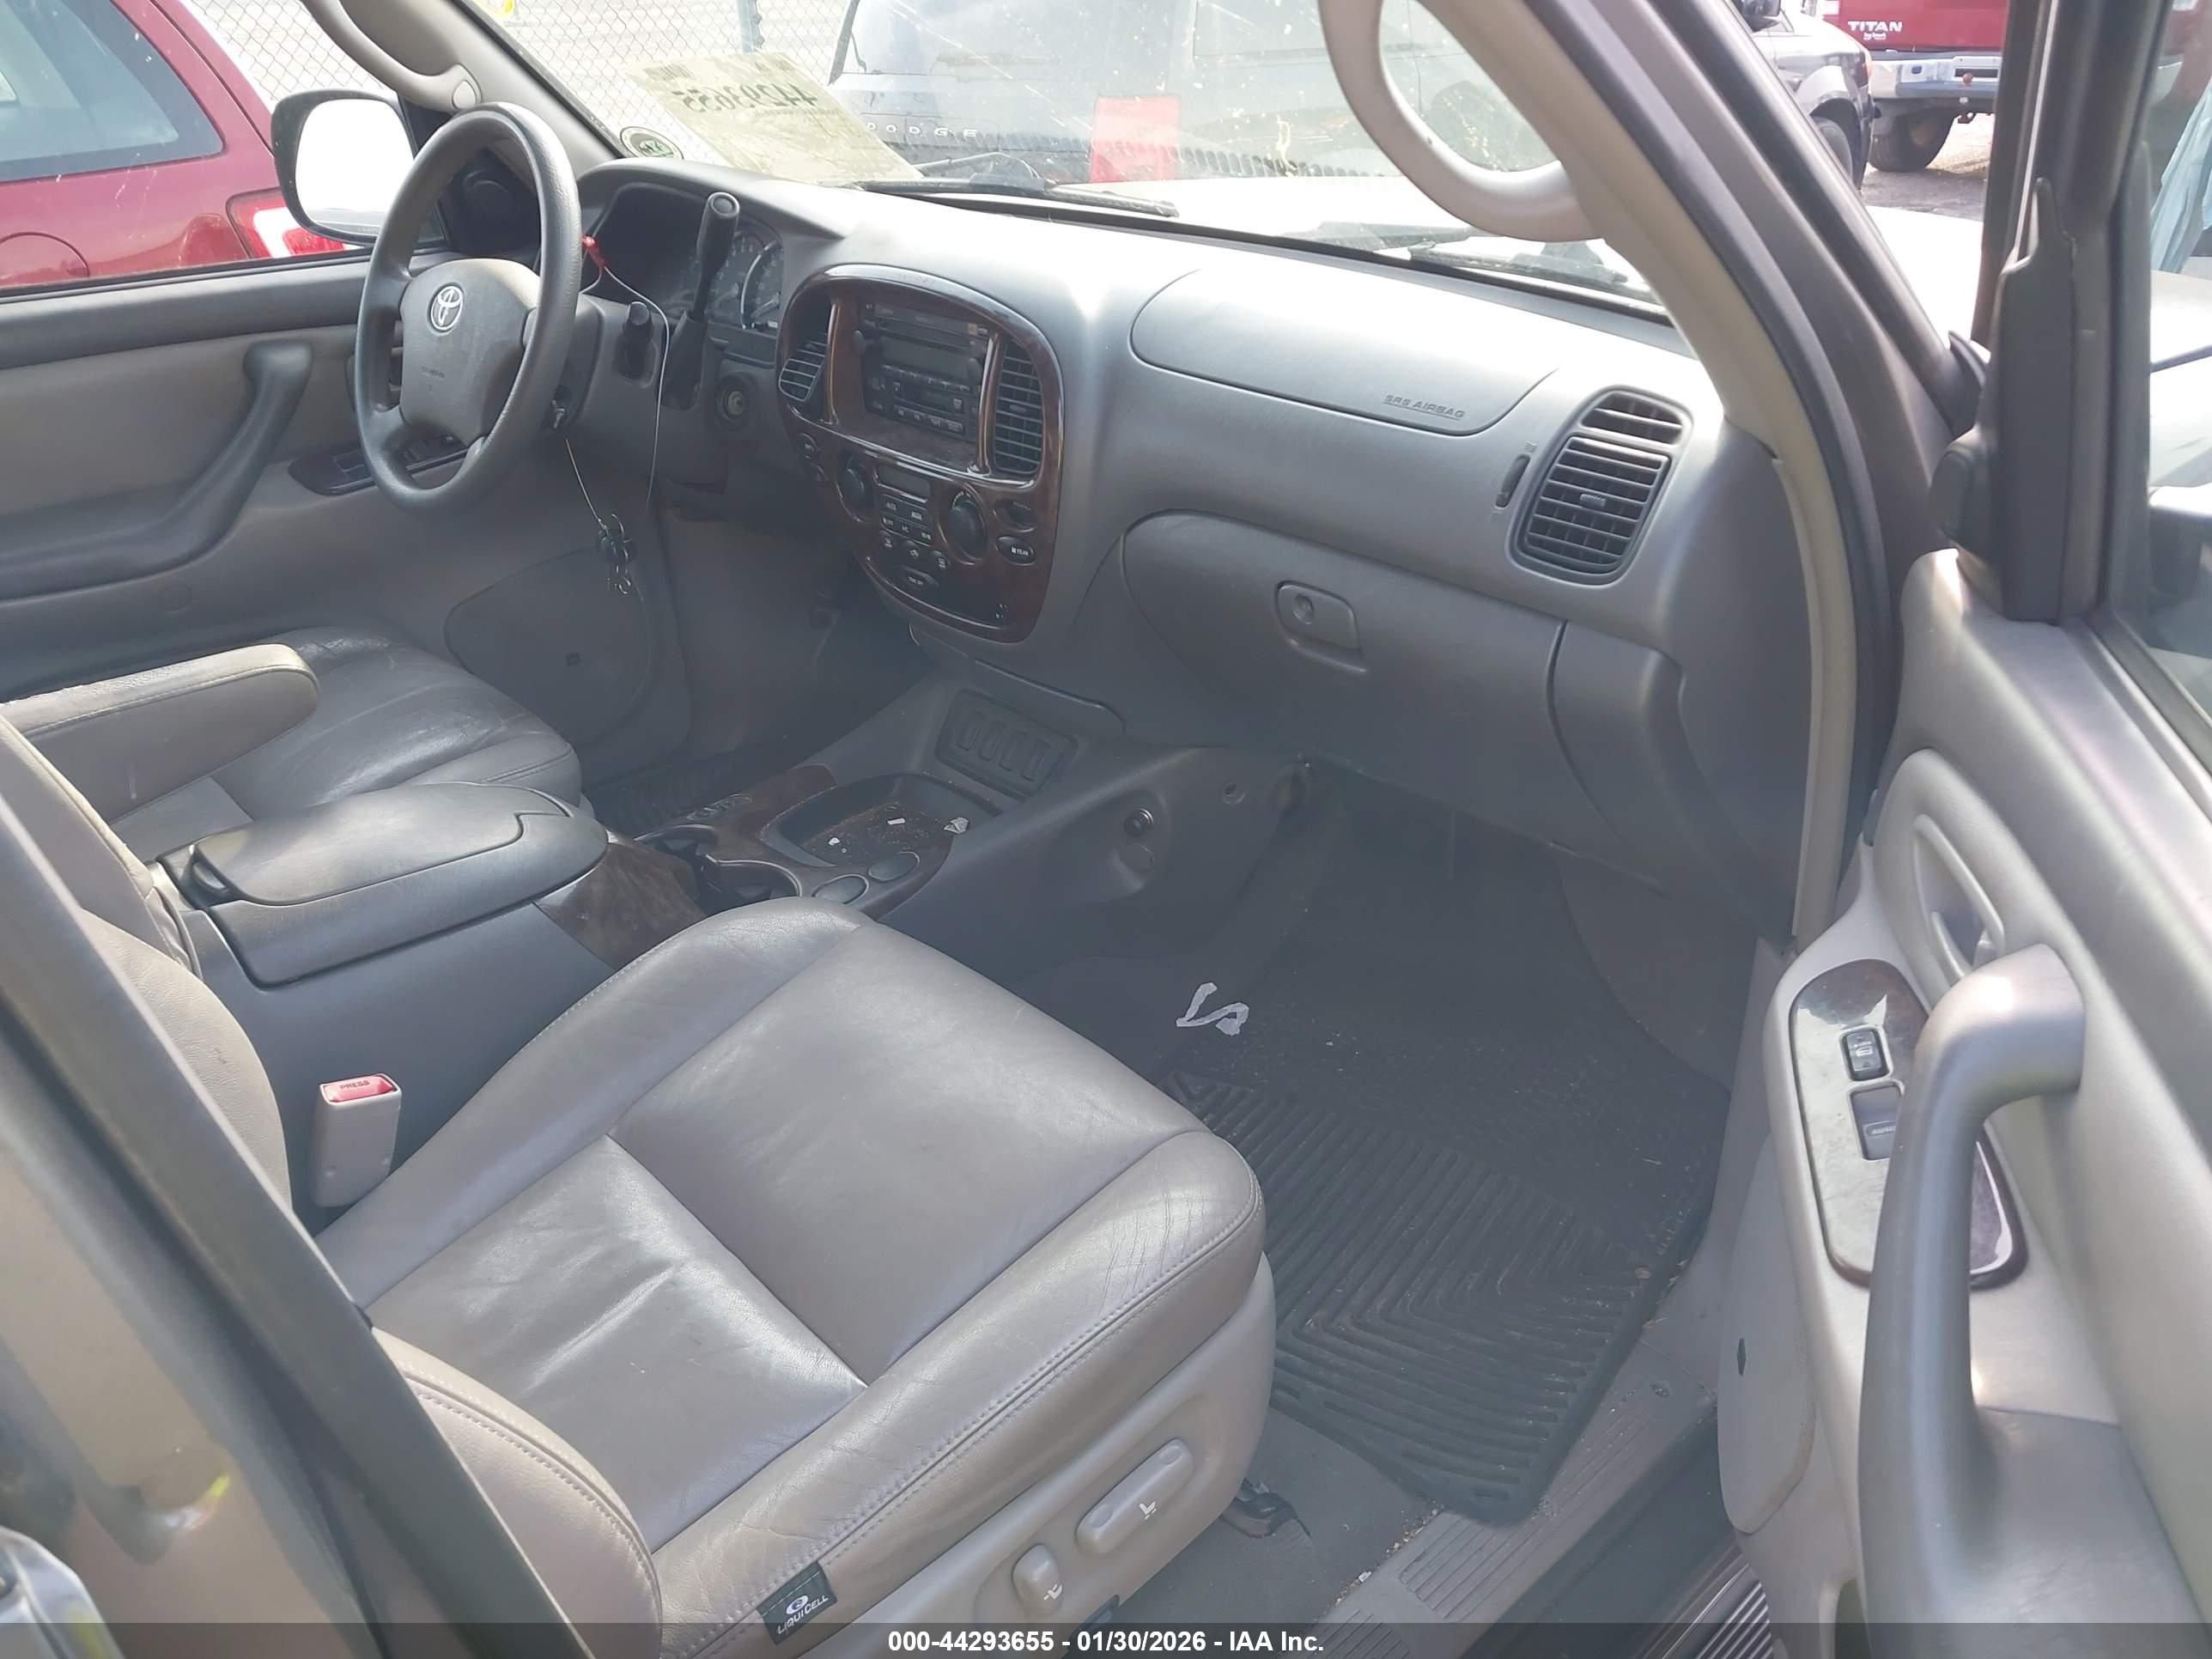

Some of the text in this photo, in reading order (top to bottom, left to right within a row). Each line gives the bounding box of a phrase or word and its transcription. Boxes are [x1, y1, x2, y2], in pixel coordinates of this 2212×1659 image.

[1847, 21, 1903, 32] TITAN
[866, 122, 978, 137] DODGE
[1385, 394, 1465, 418] SRS AIRBAG
[340, 1079, 370, 1090] PRESS
[776, 1595, 830, 1635] LIQUICELL
